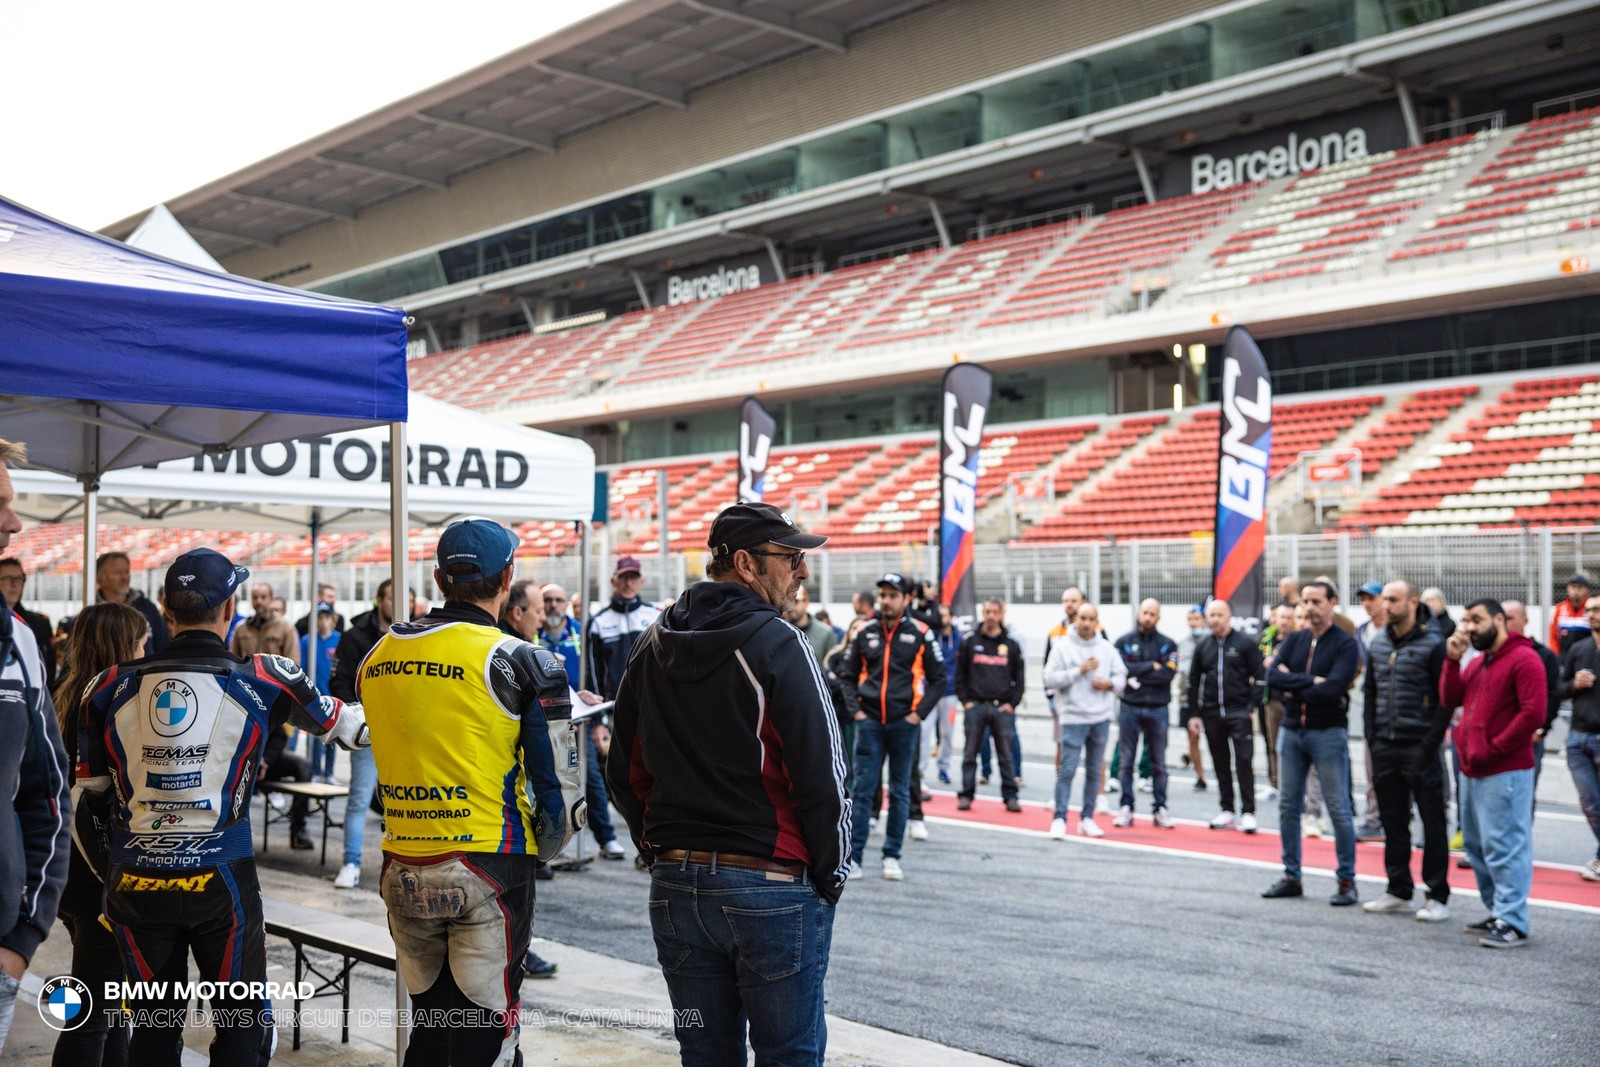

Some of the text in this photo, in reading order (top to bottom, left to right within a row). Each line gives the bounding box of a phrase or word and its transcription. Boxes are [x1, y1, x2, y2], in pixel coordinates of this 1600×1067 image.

[1191, 127, 1368, 195] Barcelona
[668, 265, 760, 306] Barcelona
[365, 660, 465, 681] INSTRUCTEUR
[154, 681, 192, 698] BMW
[161, 778, 200, 789] motards
[153, 801, 207, 810] MICHELIN
[386, 808, 471, 820] BMW MOTORRAD
